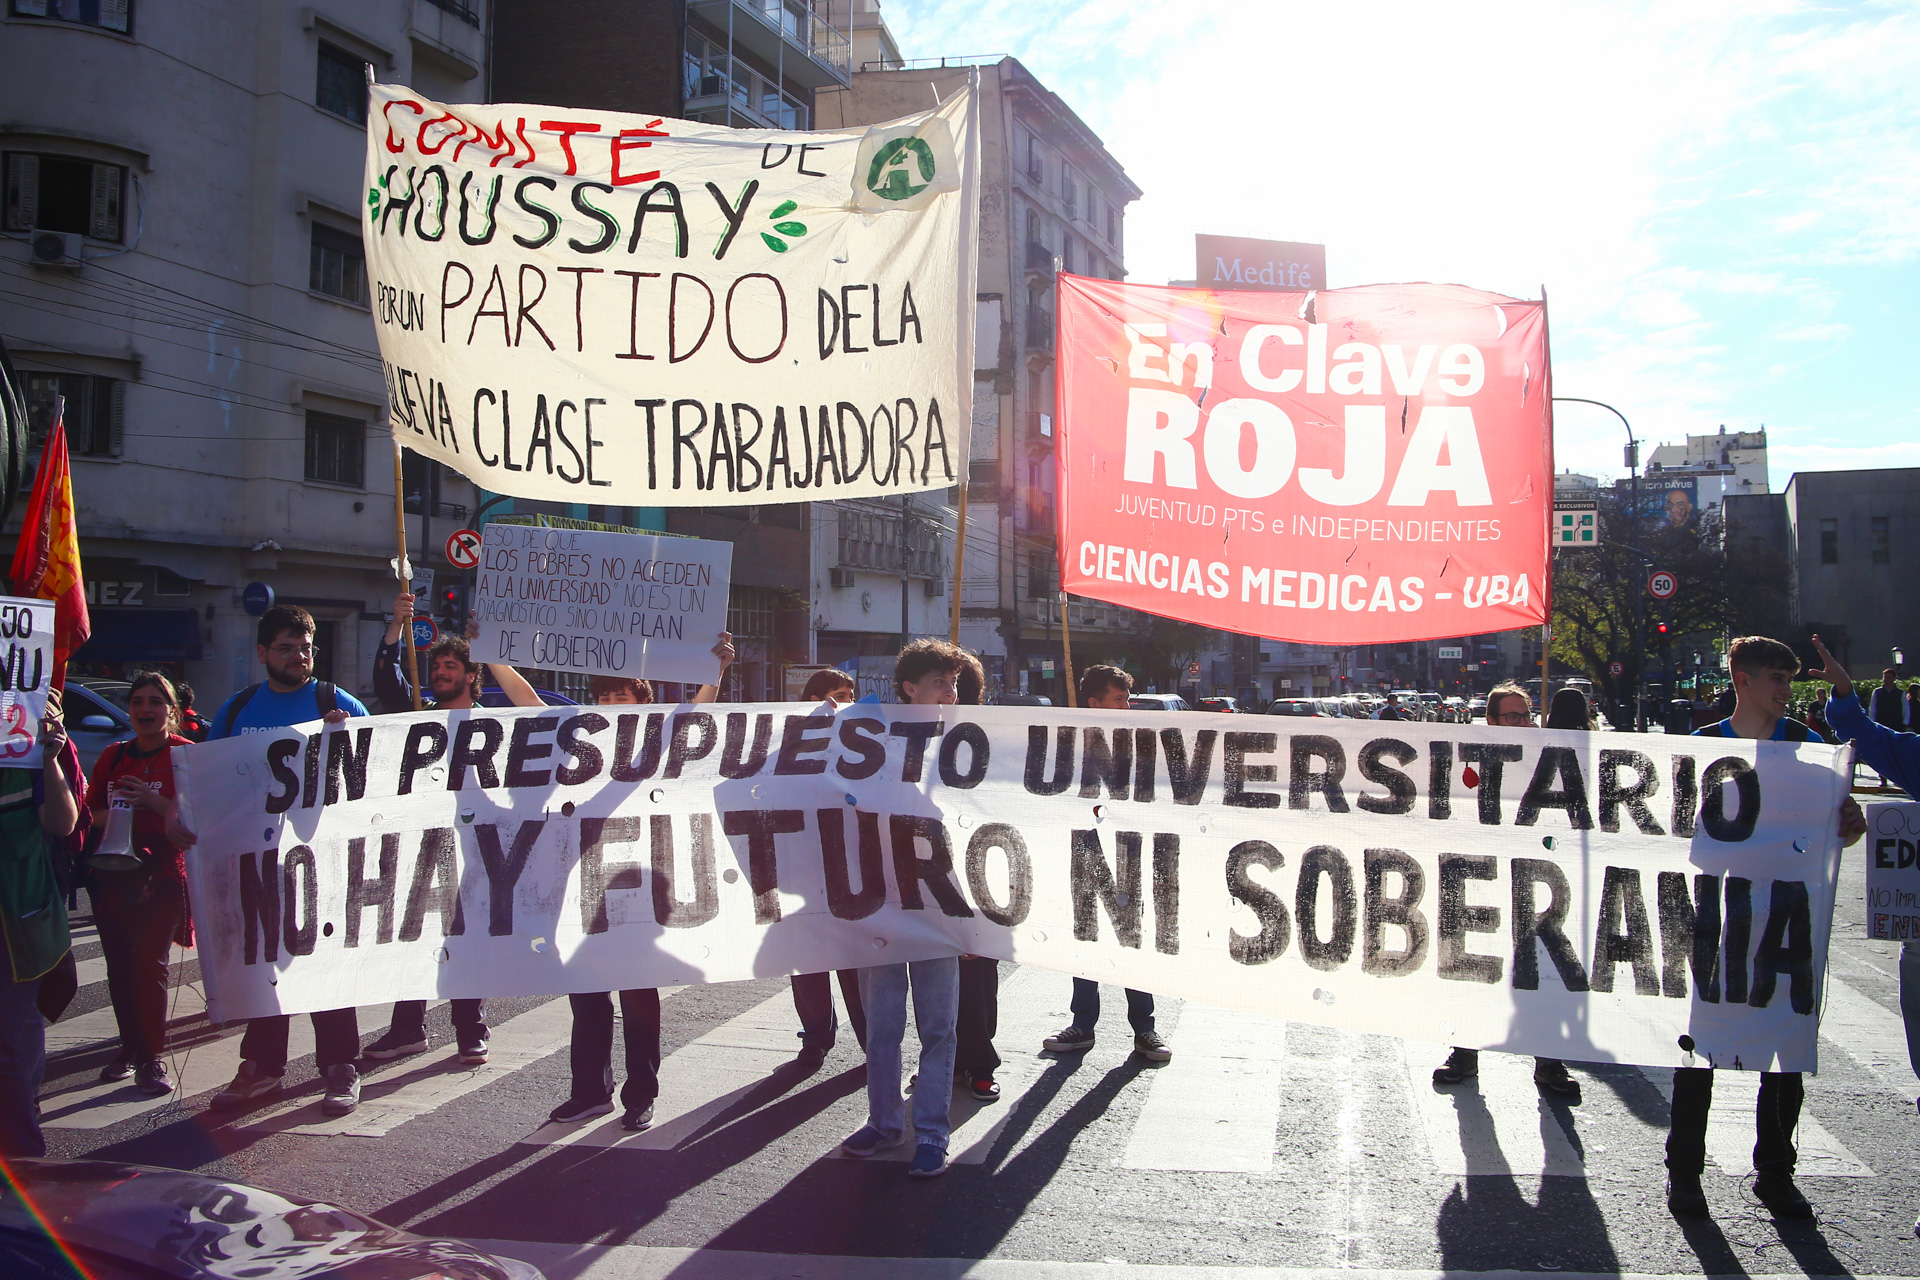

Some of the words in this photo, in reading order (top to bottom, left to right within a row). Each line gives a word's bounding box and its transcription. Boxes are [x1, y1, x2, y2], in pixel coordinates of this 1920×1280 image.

[383, 99, 669, 186] COMITÉ
[761, 143, 827, 177] DE
[381, 164, 759, 260] HOUSSAY
[1213, 257, 1311, 288] Medifé
[441, 260, 788, 364] PARTIDO
[1123, 322, 1213, 389] En
[1239, 322, 1485, 396] Clave
[473, 387, 612, 487] CLASE
[635, 397, 955, 492] TRABAJADORA
[1123, 386, 1494, 507] ROJA
[1664, 481, 1693, 489] DAYUB
[1115, 494, 1216, 526] JUVENTUD
[1222, 508, 1265, 532] PTS
[1272, 519, 1284, 534] e
[1292, 514, 1501, 542] INDEPENDIENTES
[483, 526, 514, 547] ESO
[522, 529, 541, 548] DE
[545, 530, 583, 553] QUE
[528, 551, 592, 577] POBRES
[601, 557, 625, 580] NO
[631, 559, 711, 586] ACCEDEN
[1079, 540, 1229, 599] CIENCIAS
[1241, 565, 1425, 612] MEDICAS
[1463, 573, 1529, 608] UBA
[1654, 579, 1671, 591] 50
[479, 574, 489, 597] A
[495, 575, 514, 598] LA
[680, 587, 705, 613] UN
[0, 606, 32, 639] JO
[603, 610, 624, 633] UN
[630, 612, 682, 640] PLAN
[500, 630, 521, 662] DE
[265, 727, 373, 814] SIN
[397, 711, 990, 795] PRESUPUESTO
[1023, 725, 1761, 842] UNIVERSITARIO
[1875, 838, 1920, 870] ED
[239, 844, 318, 966] NO
[344, 820, 548, 949] HAY
[579, 807, 1033, 935] FUTURO
[1070, 828, 1180, 955] NI
[1225, 840, 1814, 1016] SOBERANIA
[1869, 887, 1891, 908] NO
